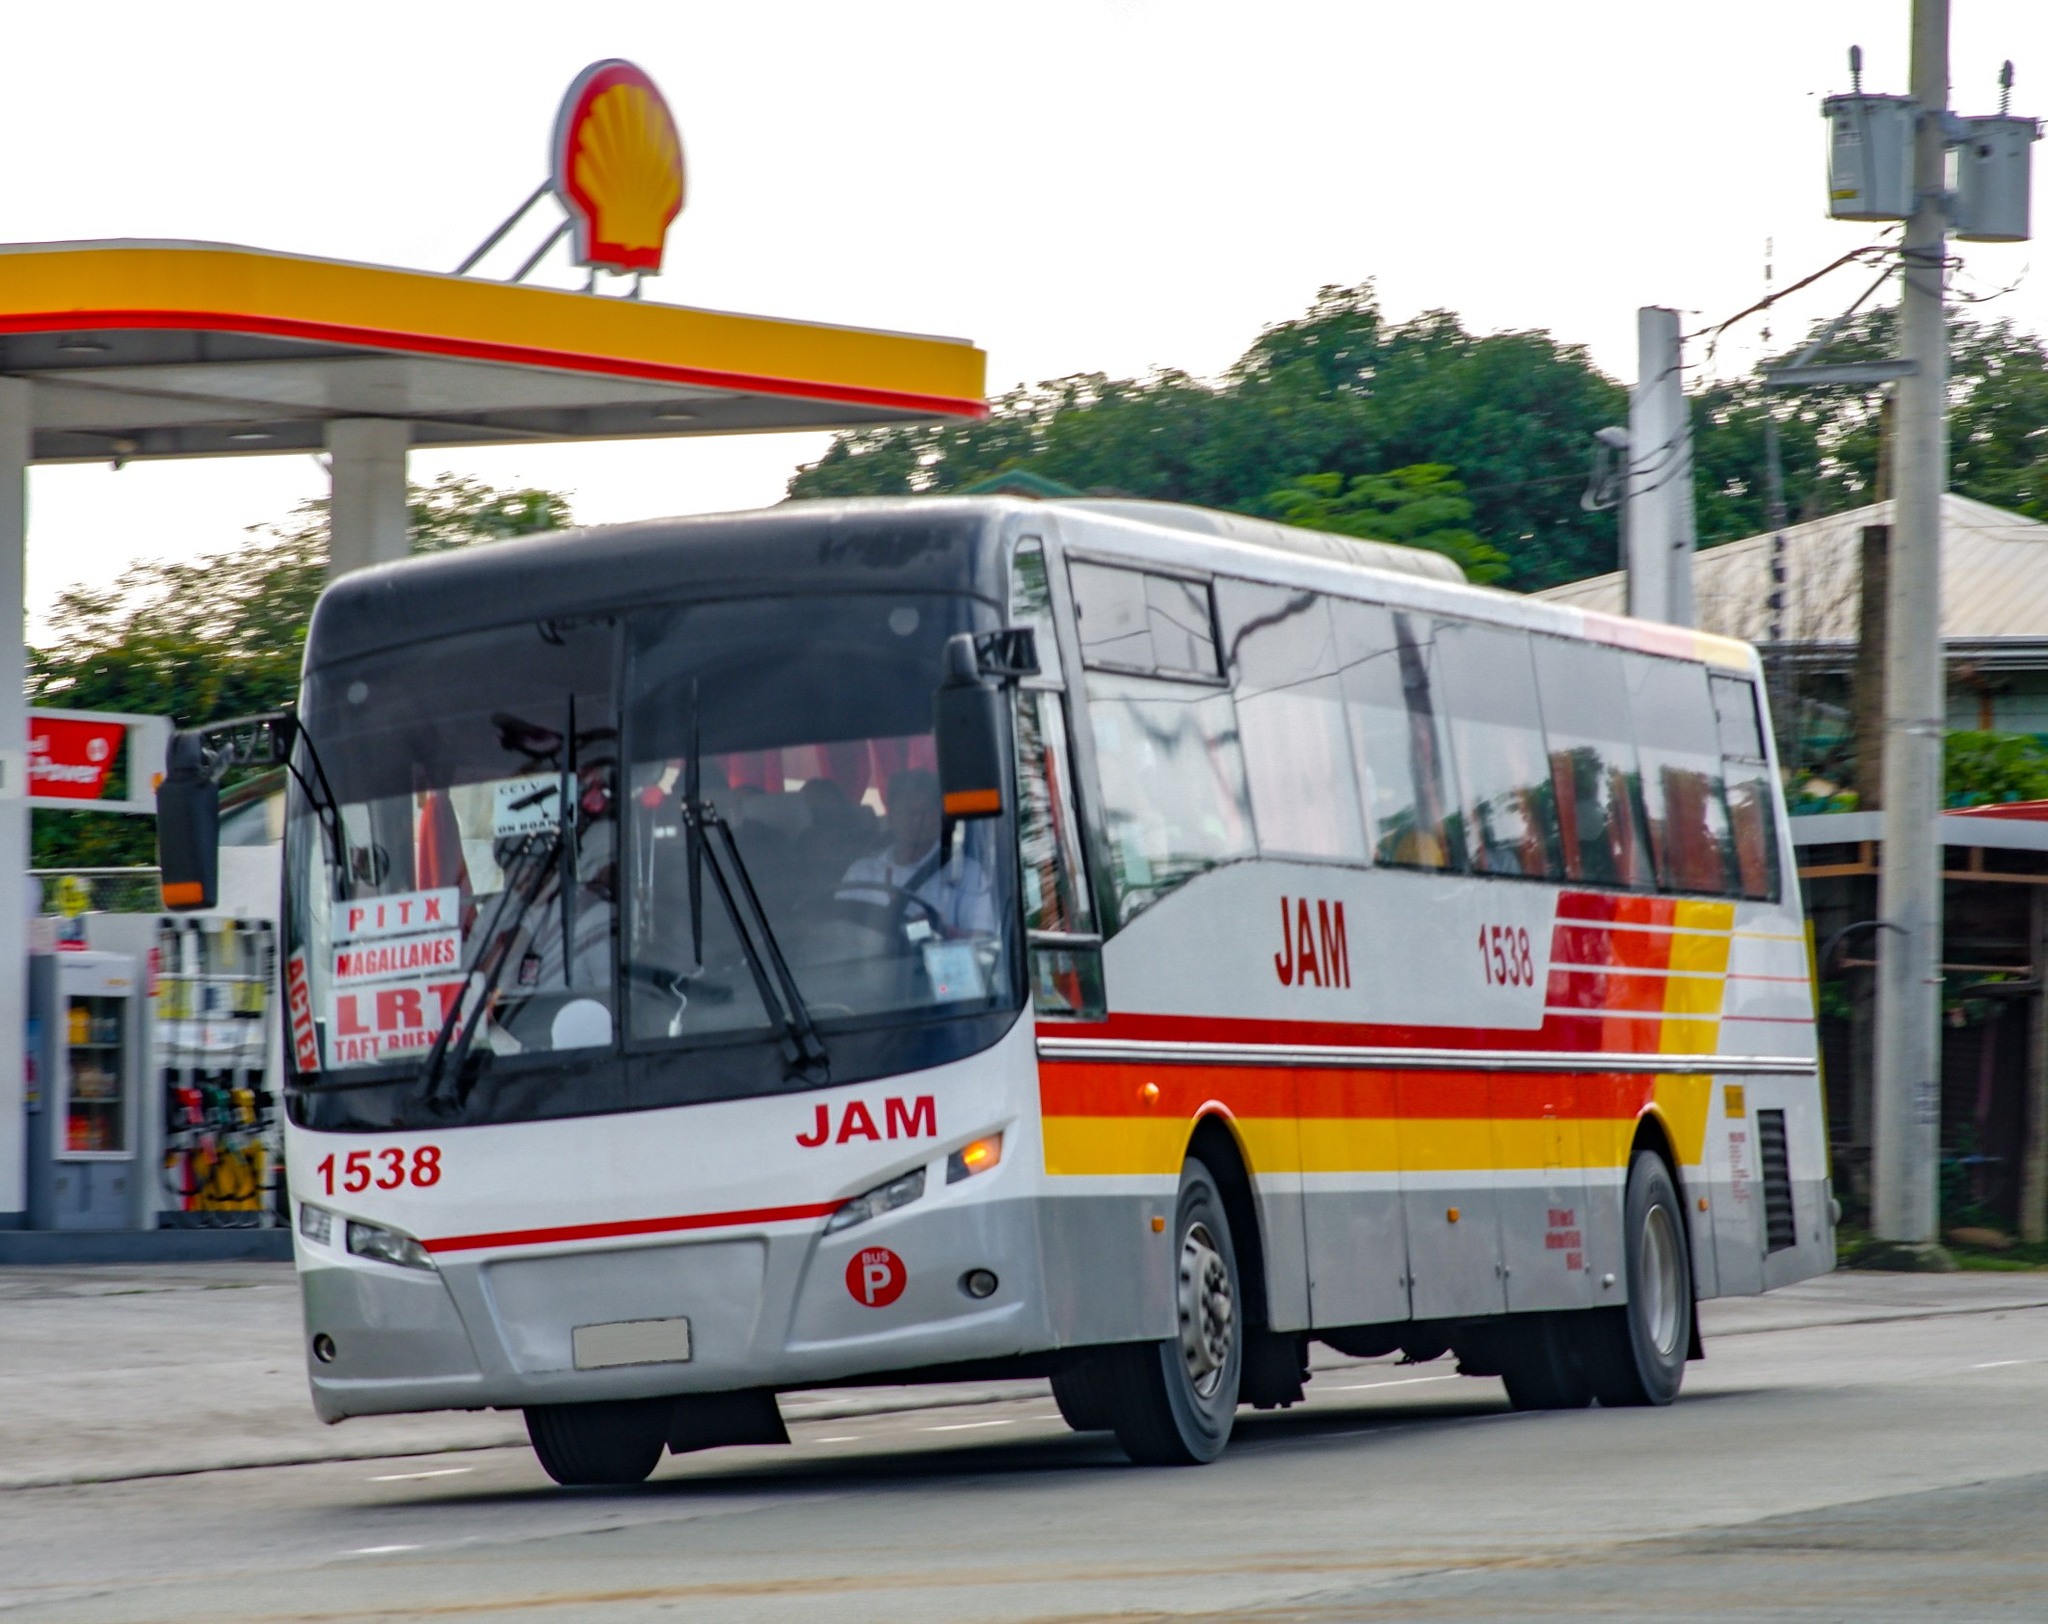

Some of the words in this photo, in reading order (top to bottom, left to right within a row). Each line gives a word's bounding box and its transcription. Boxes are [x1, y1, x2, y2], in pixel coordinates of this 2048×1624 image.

[349, 897, 441, 932] PITX
[336, 938, 455, 979] MAGALLANES
[1274, 896, 1351, 989] JAM
[1479, 924, 1534, 987] 1538
[336, 982, 465, 1036] LRT
[334, 1037, 380, 1062] TAFT
[795, 1095, 938, 1149] JAM
[316, 1145, 443, 1197] 1538
[861, 1250, 889, 1264] BUS
[863, 1265, 891, 1304] P
